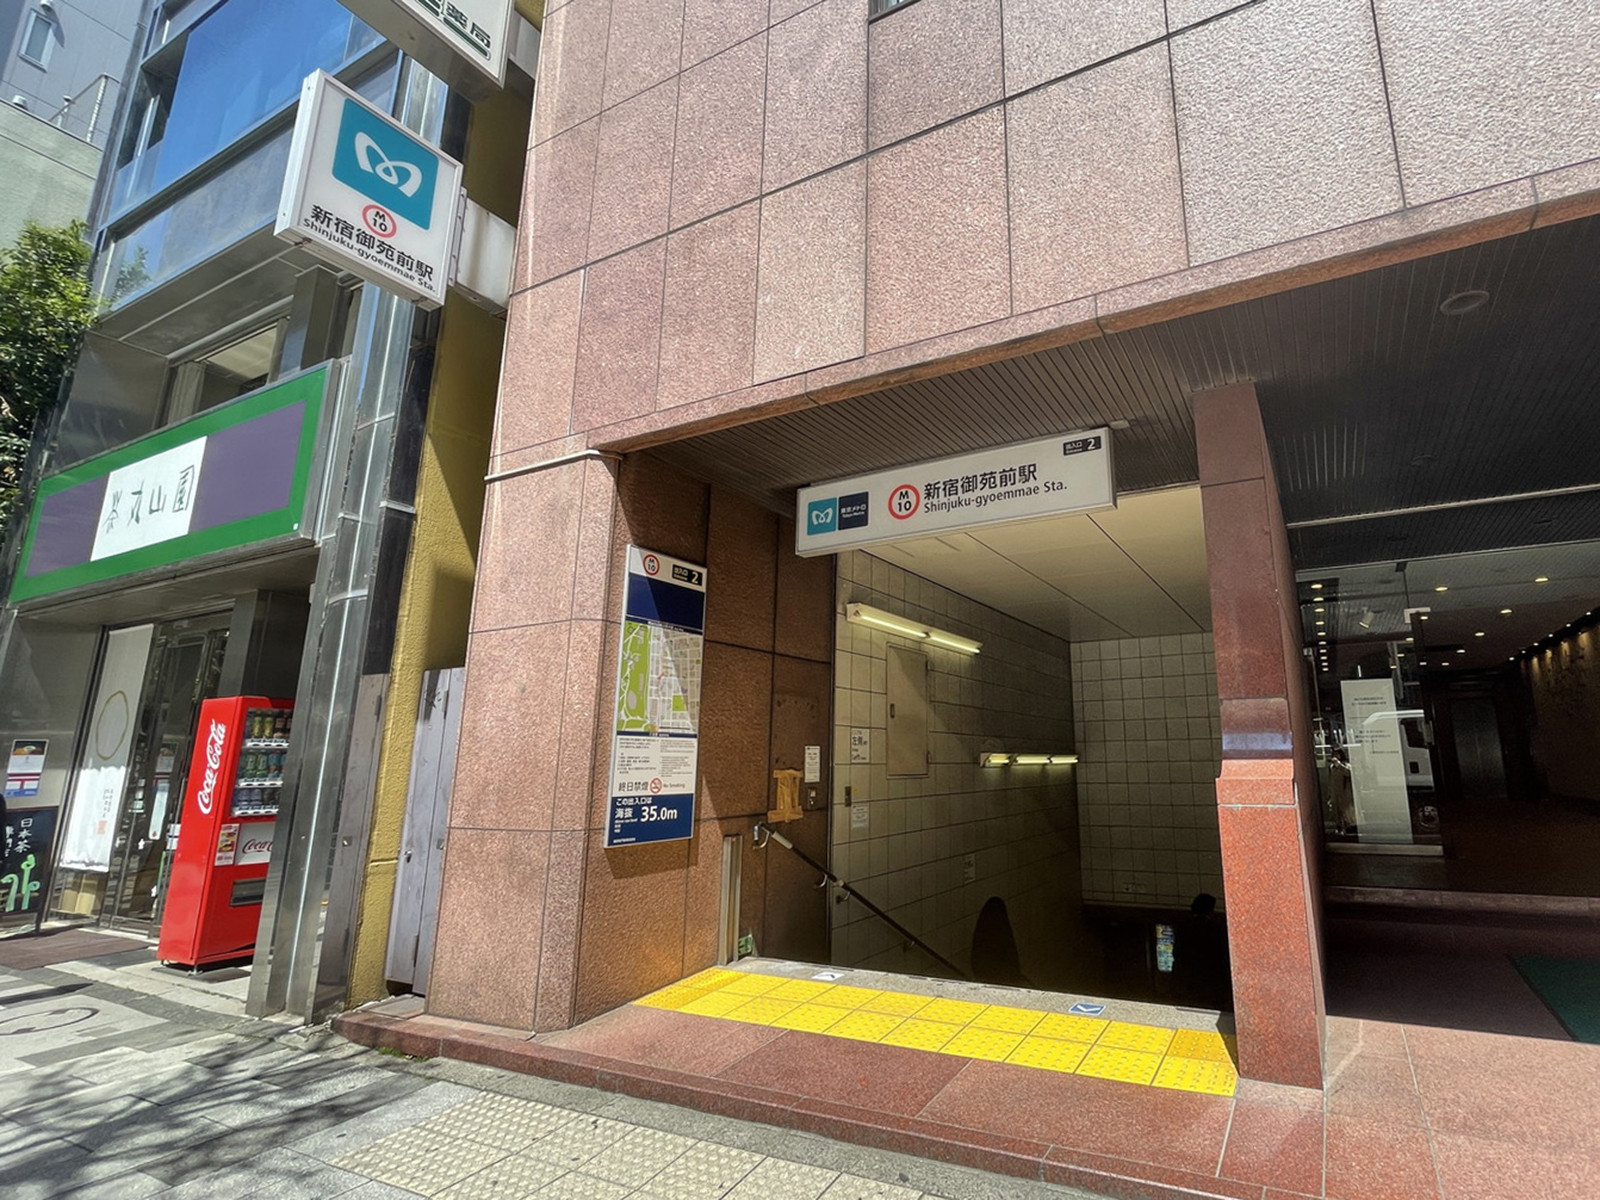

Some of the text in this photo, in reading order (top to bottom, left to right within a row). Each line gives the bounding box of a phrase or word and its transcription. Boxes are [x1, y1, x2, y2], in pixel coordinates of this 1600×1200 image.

[445, 1, 492, 49] 薬局
[372, 217, 388, 233] 10
[374, 210, 386, 222] M
[303, 217, 436, 293] Shinjuku-gyoemmae Sta.
[310, 203, 435, 282] 新宿御苑前駅
[1087, 438, 1096, 450] 2
[923, 463, 1038, 501] 新宿御苑前駅
[897, 501, 912, 512] 10
[899, 490, 910, 501] M
[924, 479, 1068, 514] Shinjuku-gyoemmae Sta.
[692, 571, 698, 583] 2
[197, 718, 226, 815] Coca-Cola
[640, 805, 678, 822] 35.0m
[14, 817, 33, 854] 日本茶
